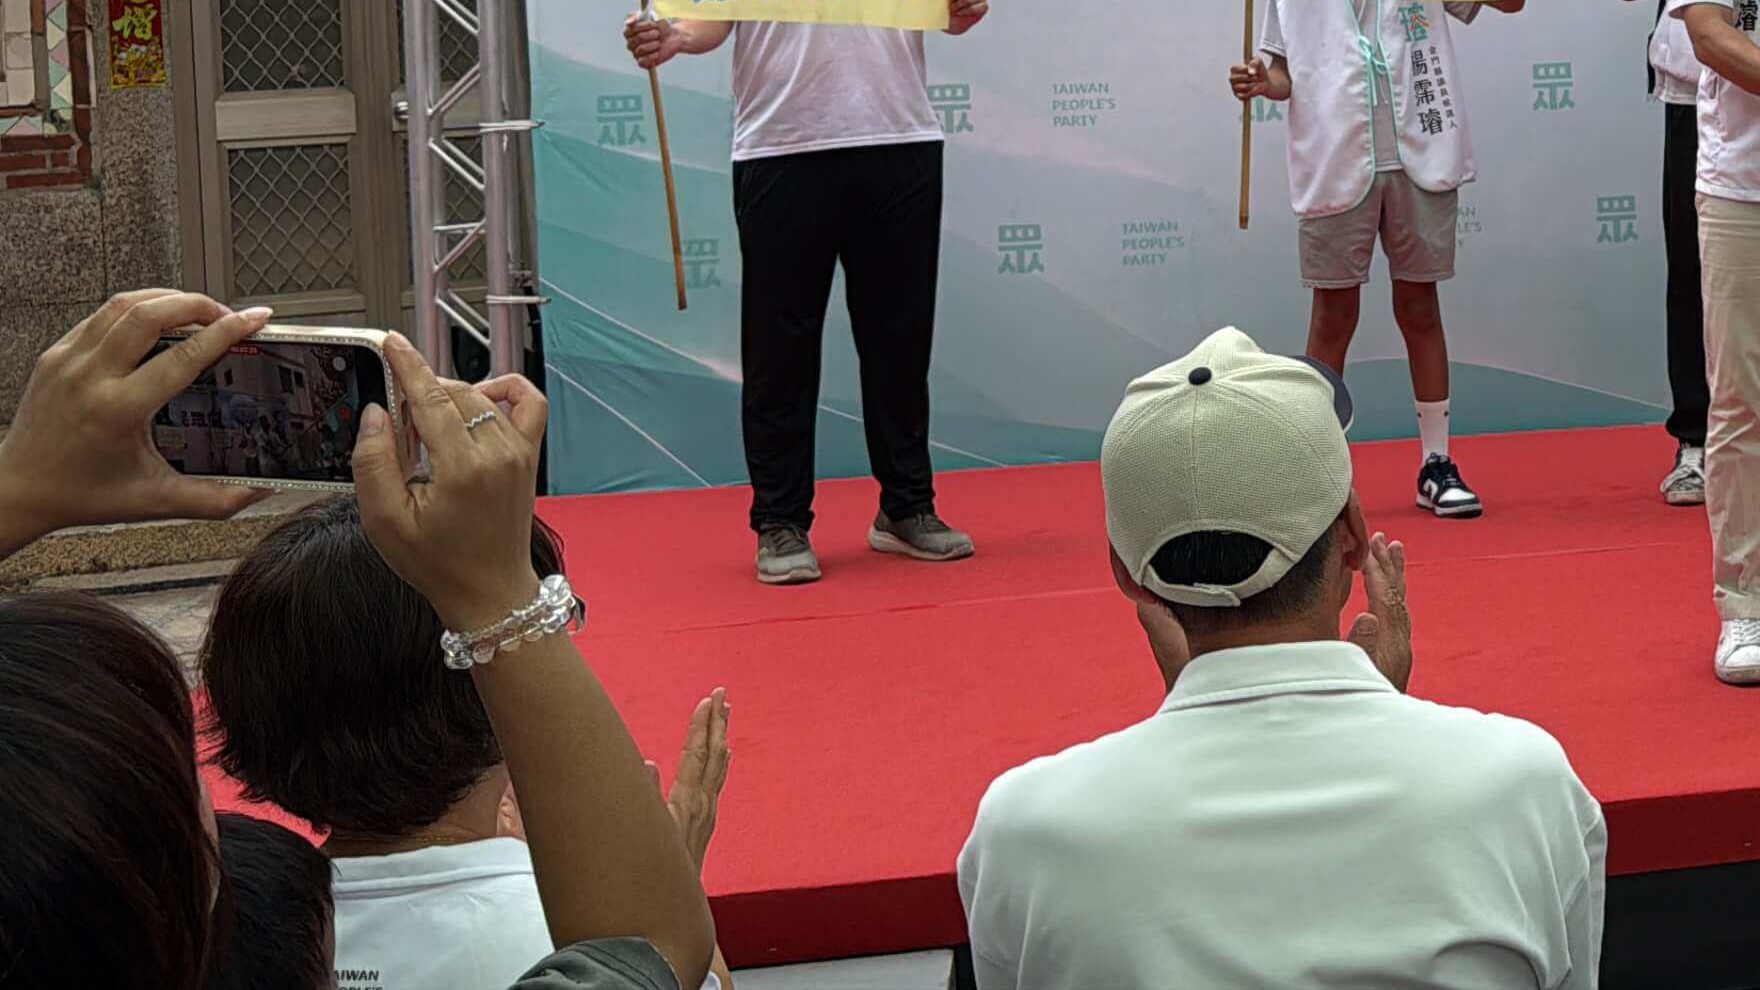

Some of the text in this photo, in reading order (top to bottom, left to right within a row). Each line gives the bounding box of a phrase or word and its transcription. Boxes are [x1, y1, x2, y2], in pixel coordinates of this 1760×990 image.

[1052, 82, 1109, 95] TAIWAN
[1052, 97, 1116, 111] PEOPLE'S
[1053, 114, 1098, 127] PARTY
[1122, 221, 1179, 234] TAIWAN
[1122, 236, 1184, 251] PEOPLE'S
[1122, 253, 1167, 266] PARTY
